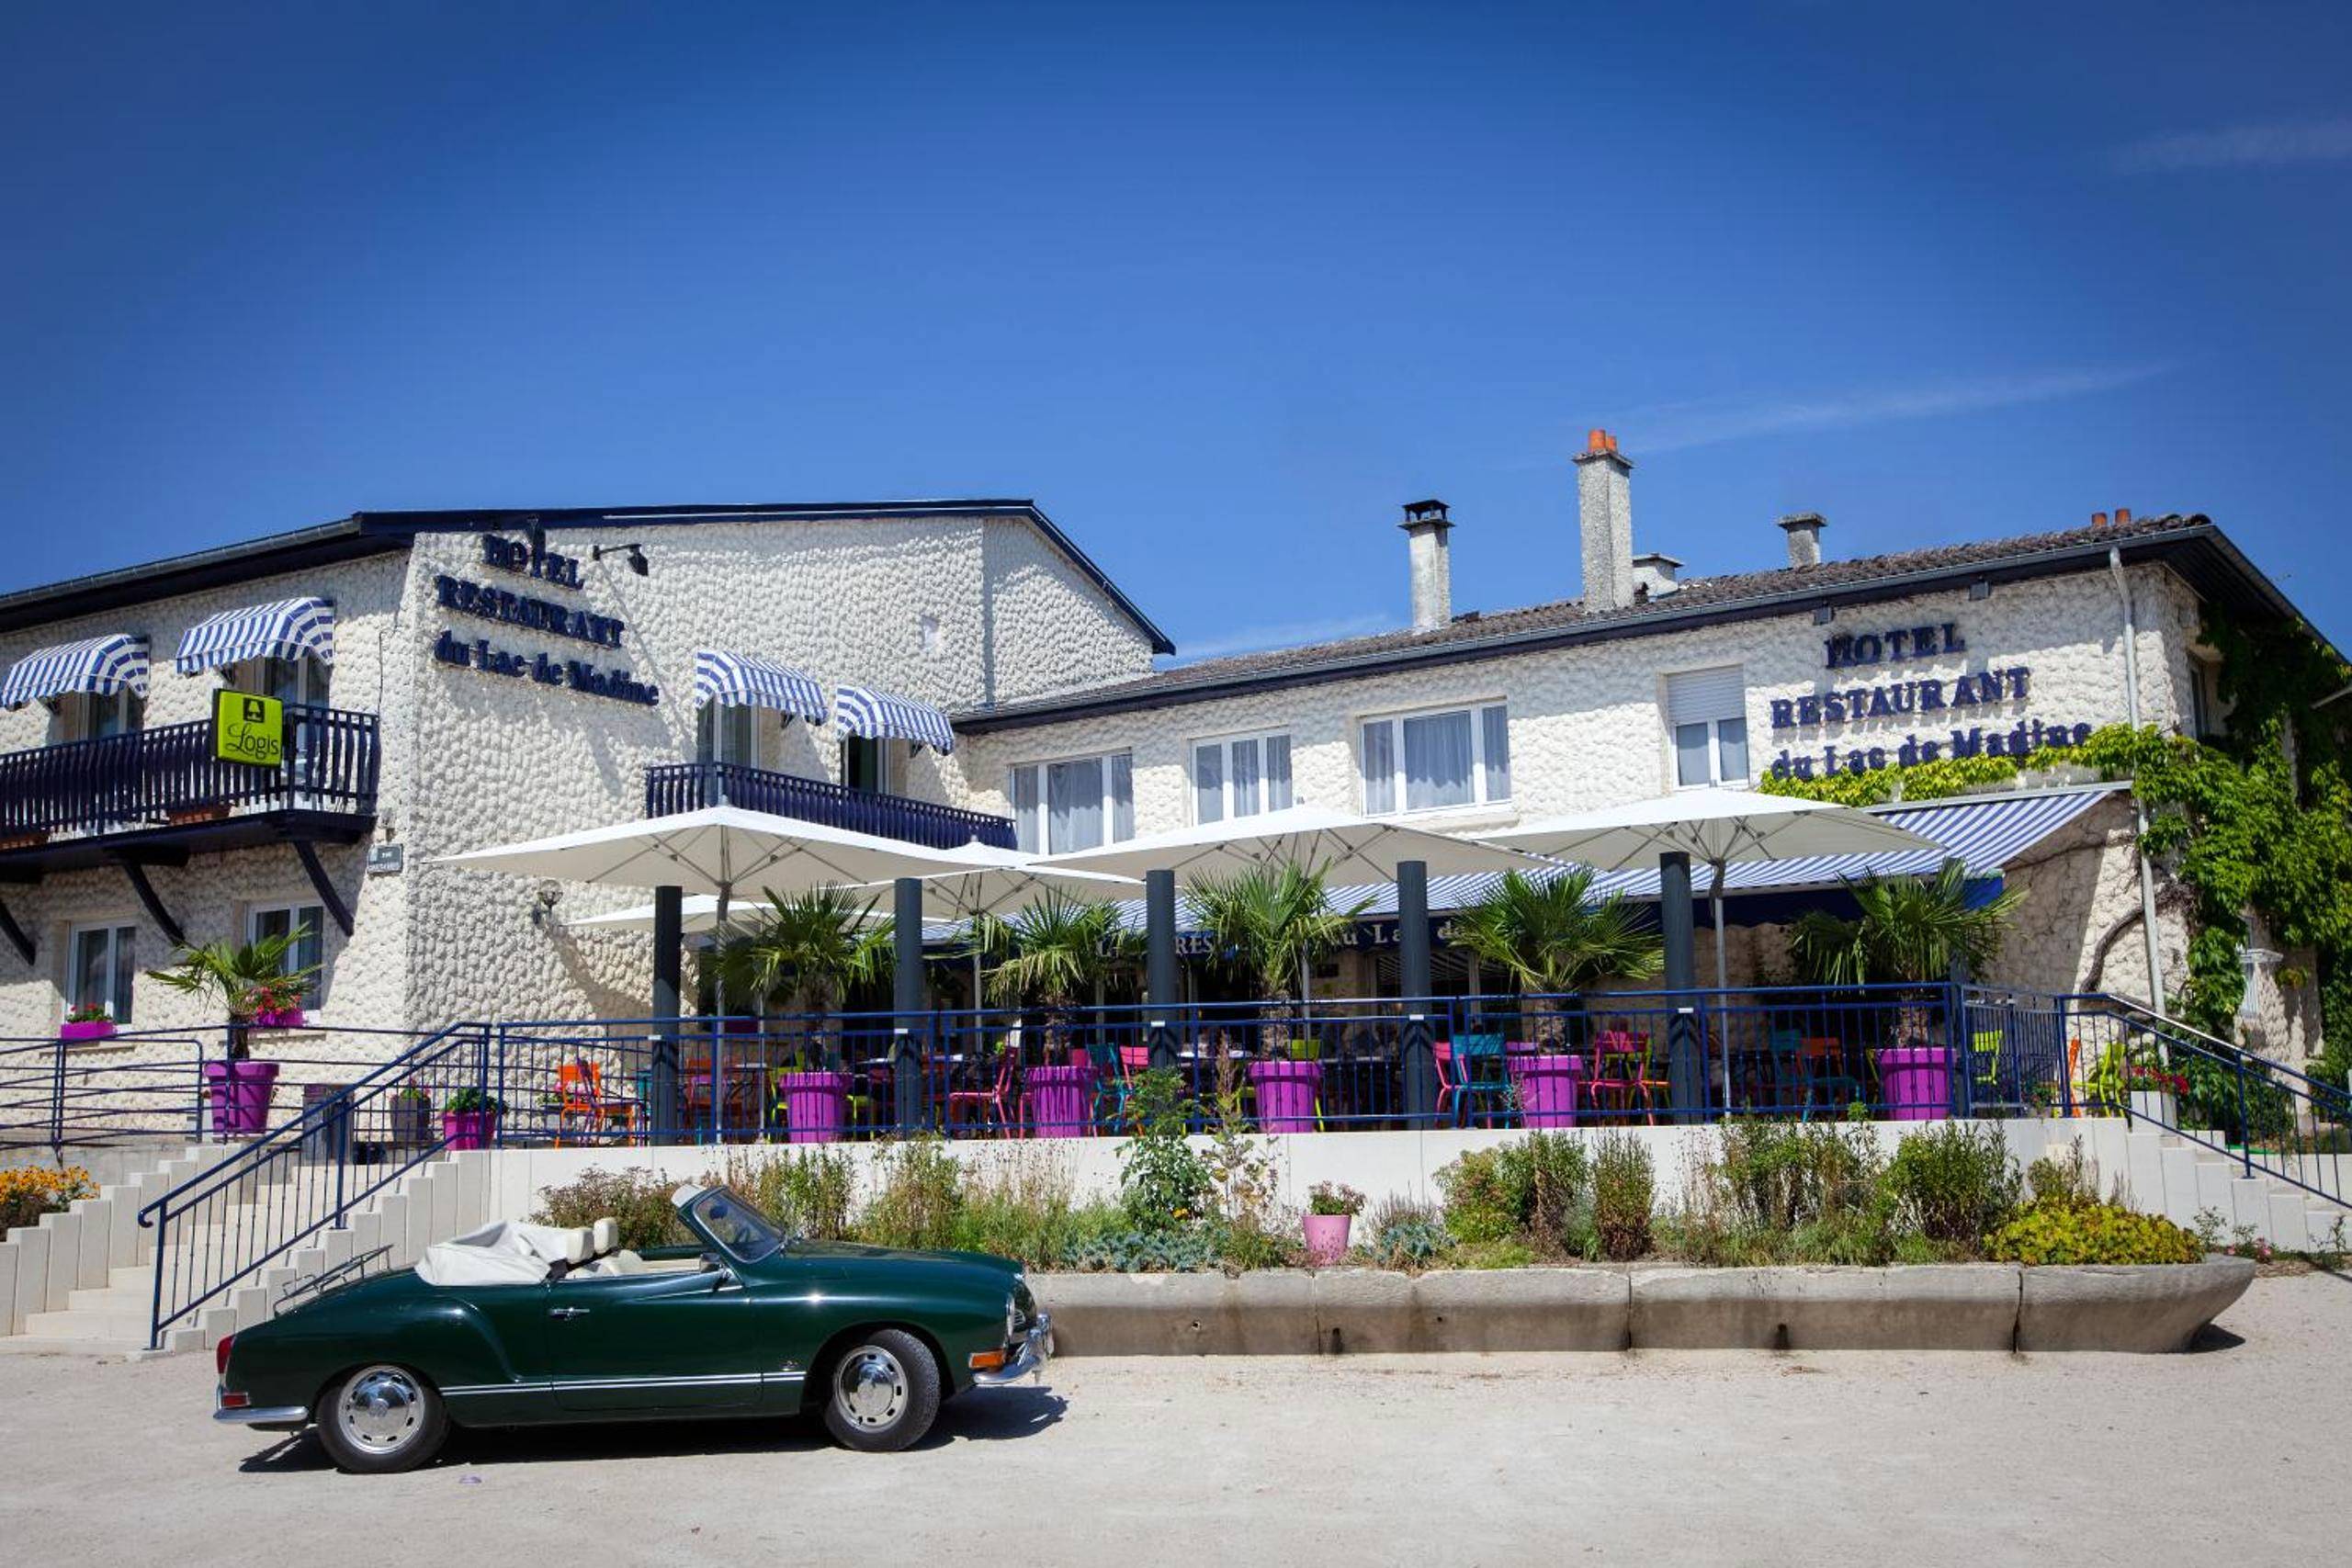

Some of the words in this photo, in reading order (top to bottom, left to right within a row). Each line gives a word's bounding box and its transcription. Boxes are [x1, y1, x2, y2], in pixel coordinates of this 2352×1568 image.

[434, 574, 626, 649] RESTAURANT
[435, 629, 471, 667] du
[476, 639, 526, 677] Lac
[532, 652, 564, 686] de
[567, 660, 660, 706] Madine
[1824, 623, 1965, 669] HOTEL
[1770, 666, 2031, 729] RESTAURANT
[225, 722, 279, 760] Logis
[1770, 750, 1815, 781] du
[1823, 745, 1887, 777] Lac
[1897, 734, 1940, 768] de
[1950, 718, 2092, 762] Madine
[1373, 923, 1402, 944] La
